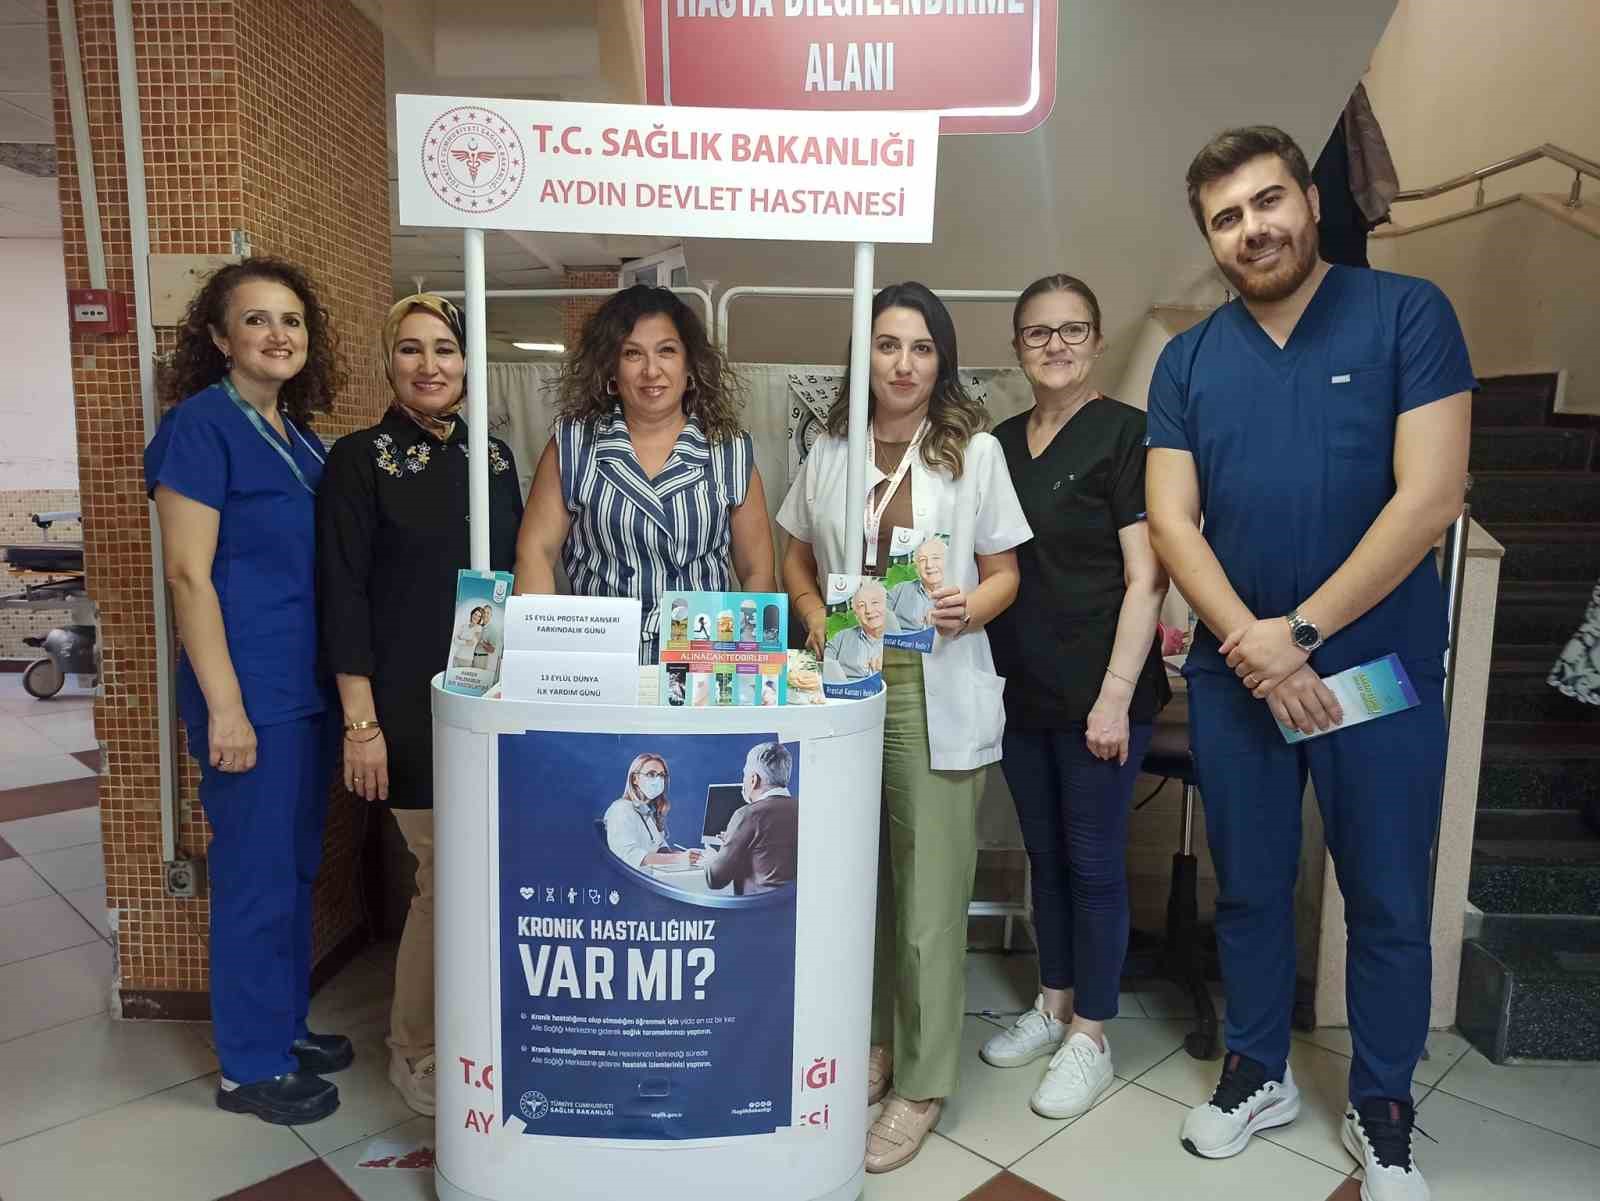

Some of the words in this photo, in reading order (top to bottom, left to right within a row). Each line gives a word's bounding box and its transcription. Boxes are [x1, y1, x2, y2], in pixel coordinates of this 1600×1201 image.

[805, 42, 895, 91] ALANI
[532, 124, 593, 156] T.C.
[601, 123, 723, 161] SAĞLIK
[731, 132, 915, 167] BAKANLIĞI
[539, 179, 626, 207] AYDIN
[636, 183, 743, 211] DEVLET
[750, 186, 905, 217] HASTANESİ
[524, 614, 533, 622] 15
[534, 614, 556, 623] EYLÜL
[557, 615, 589, 624] PROSTAT
[536, 625, 582, 634] FARKINDALIK
[584, 625, 607, 635] GÜNÜ
[541, 673, 550, 682] 13
[550, 673, 572, 683] EYLÜL
[573, 674, 599, 684] DÜNYA
[550, 687, 578, 697] YARDIM
[578, 688, 601, 698] GÜNÜ
[517, 915, 585, 940] KRONİK
[590, 918, 716, 942] HASTALIĞINIZ
[518, 943, 615, 1000] VAR
[627, 947, 716, 1001] MI?
